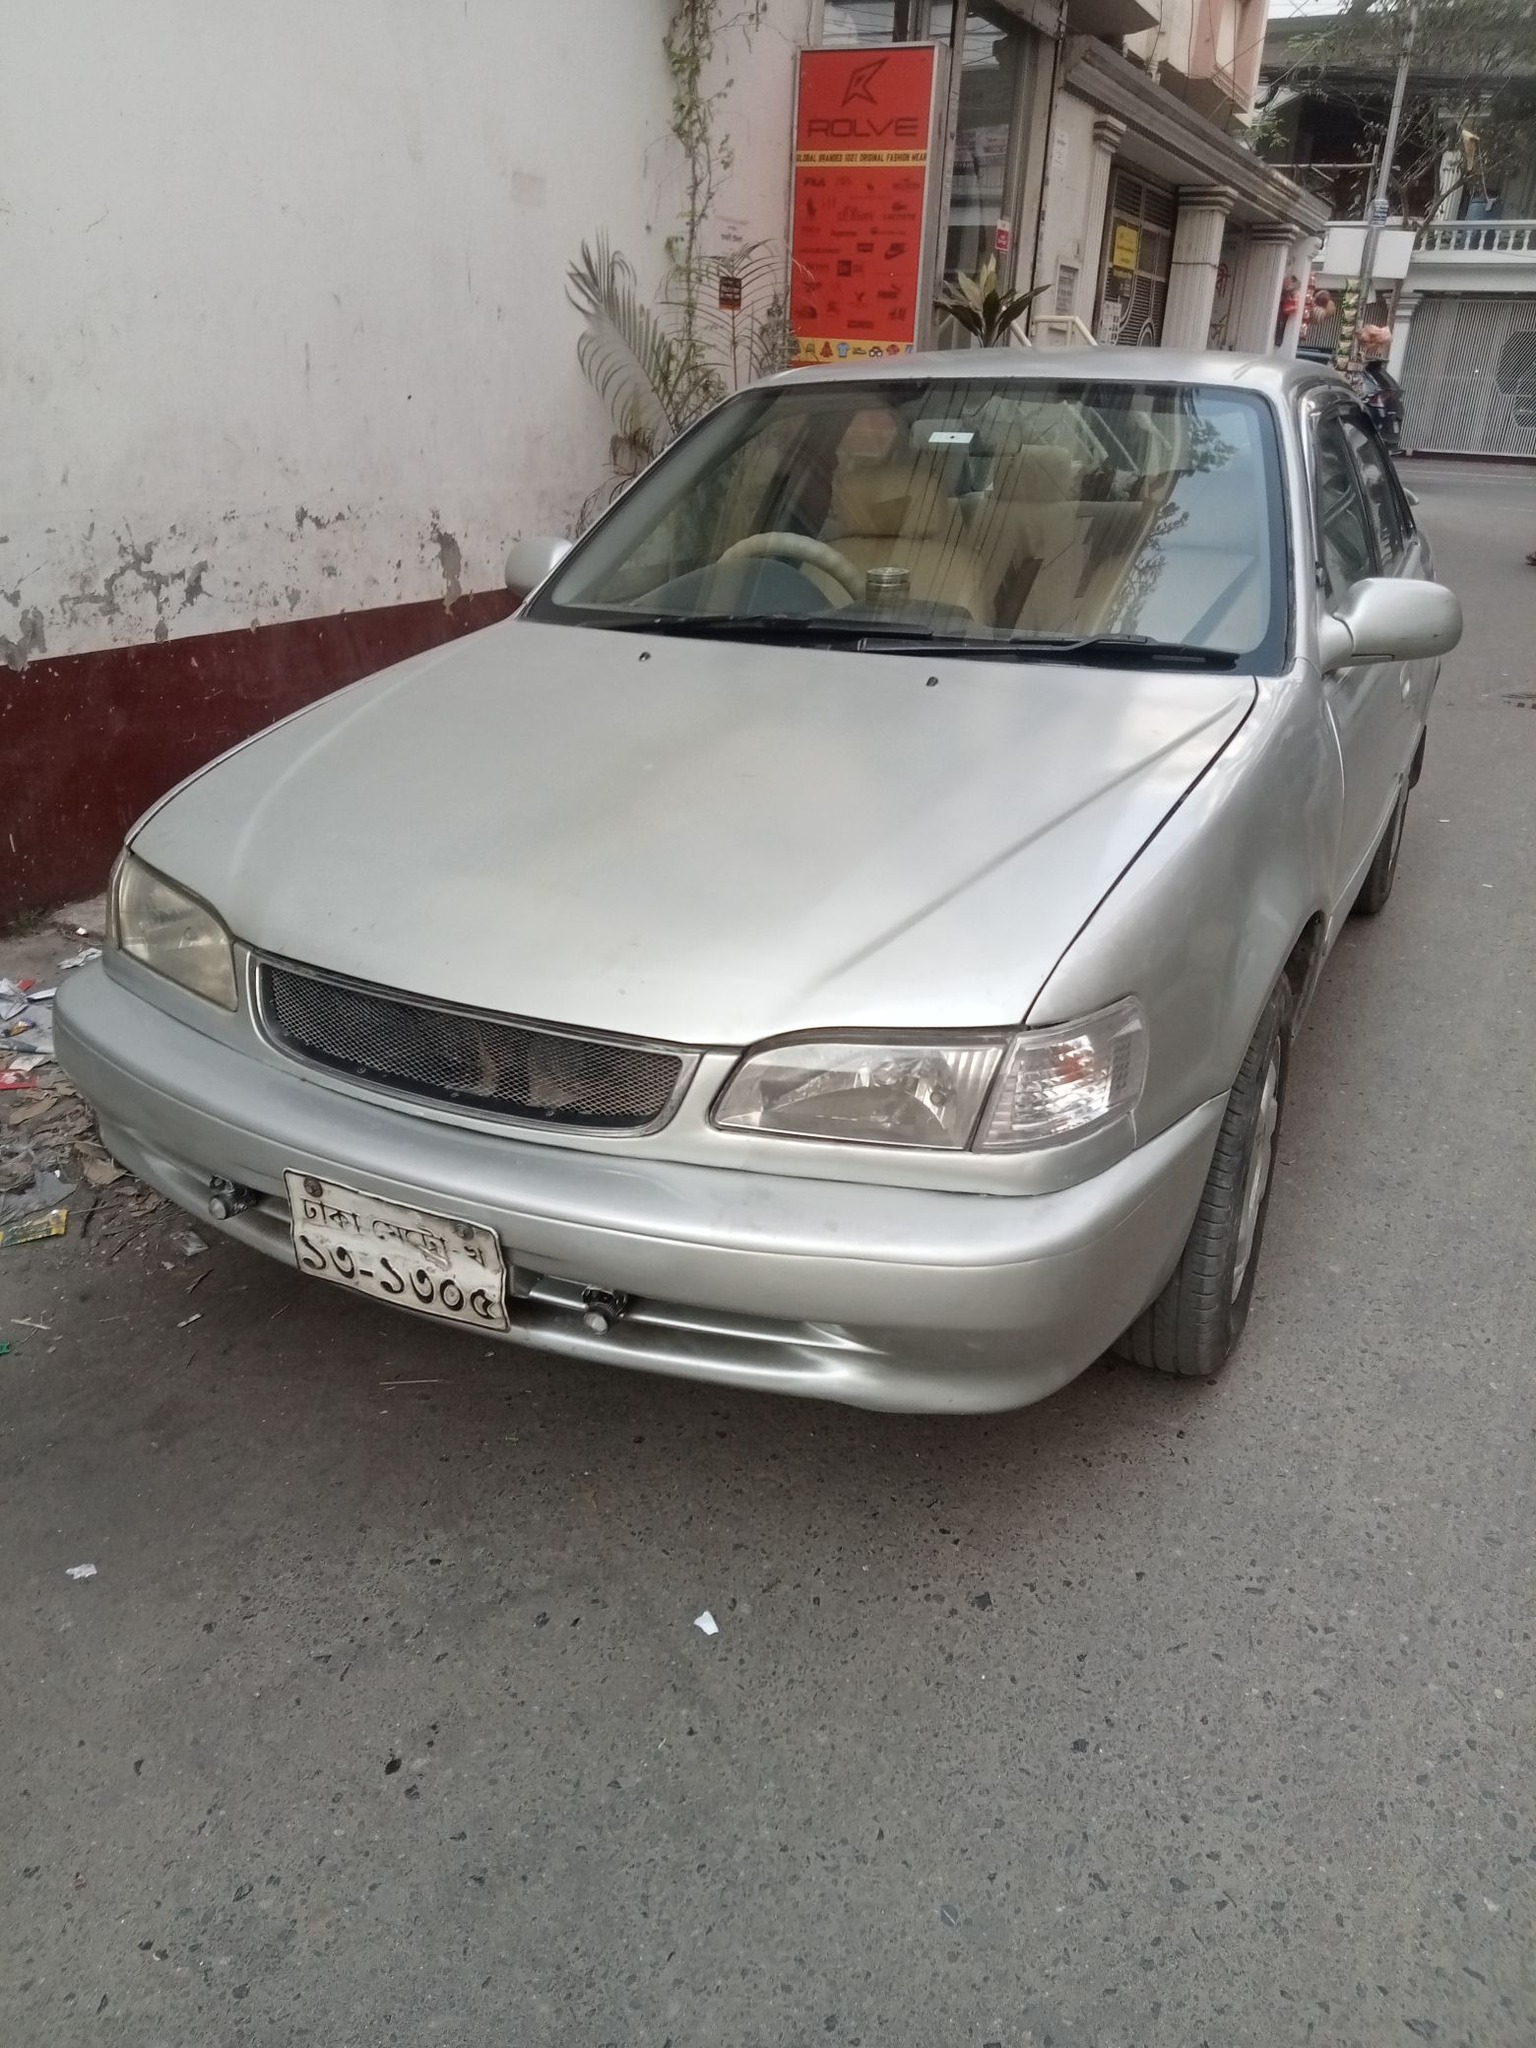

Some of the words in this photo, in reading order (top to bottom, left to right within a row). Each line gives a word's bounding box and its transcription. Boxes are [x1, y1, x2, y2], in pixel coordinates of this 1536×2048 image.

[807, 116, 919, 138] ROLVE
[885, 153, 910, 163] FASHION
[301, 1198, 360, 1233] ঢাকা
[299, 1234, 497, 1320] ১৩-১৩০৫
